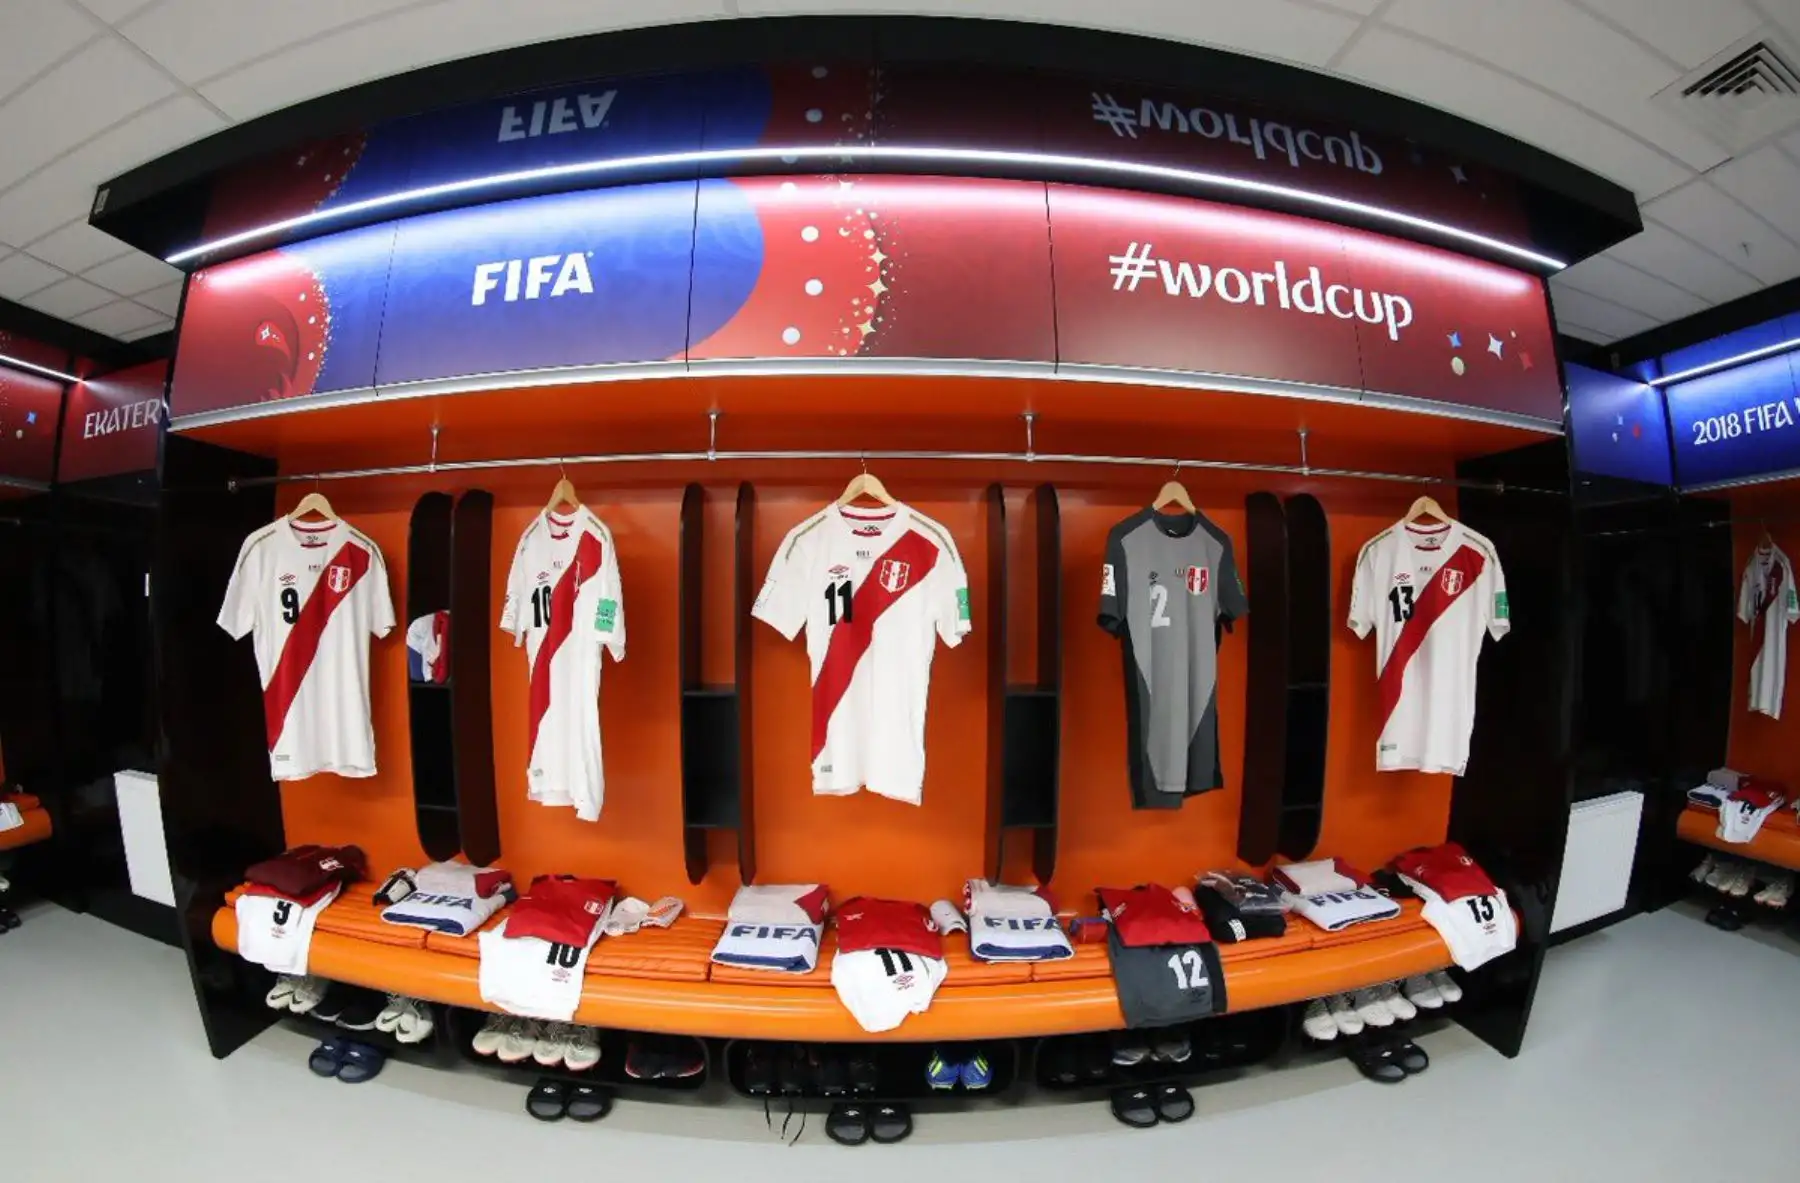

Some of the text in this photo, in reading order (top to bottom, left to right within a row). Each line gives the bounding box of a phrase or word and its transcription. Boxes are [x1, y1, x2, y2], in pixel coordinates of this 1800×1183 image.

[472, 252, 594, 306] FIFA
[1109, 241, 1413, 341] #worldcup
[83, 398, 161, 440] EKATER
[1692, 412, 1742, 445] 2018
[1743, 400, 1794, 435] FIFA
[281, 587, 300, 625] 9
[824, 580, 853, 626] 11
[1388, 585, 1415, 623] 13
[406, 892, 475, 911] FIFA
[1467, 894, 1495, 923] 13
[731, 925, 818, 948] FIFA
[874, 947, 913, 976] 11
[1168, 950, 1209, 990] 12
